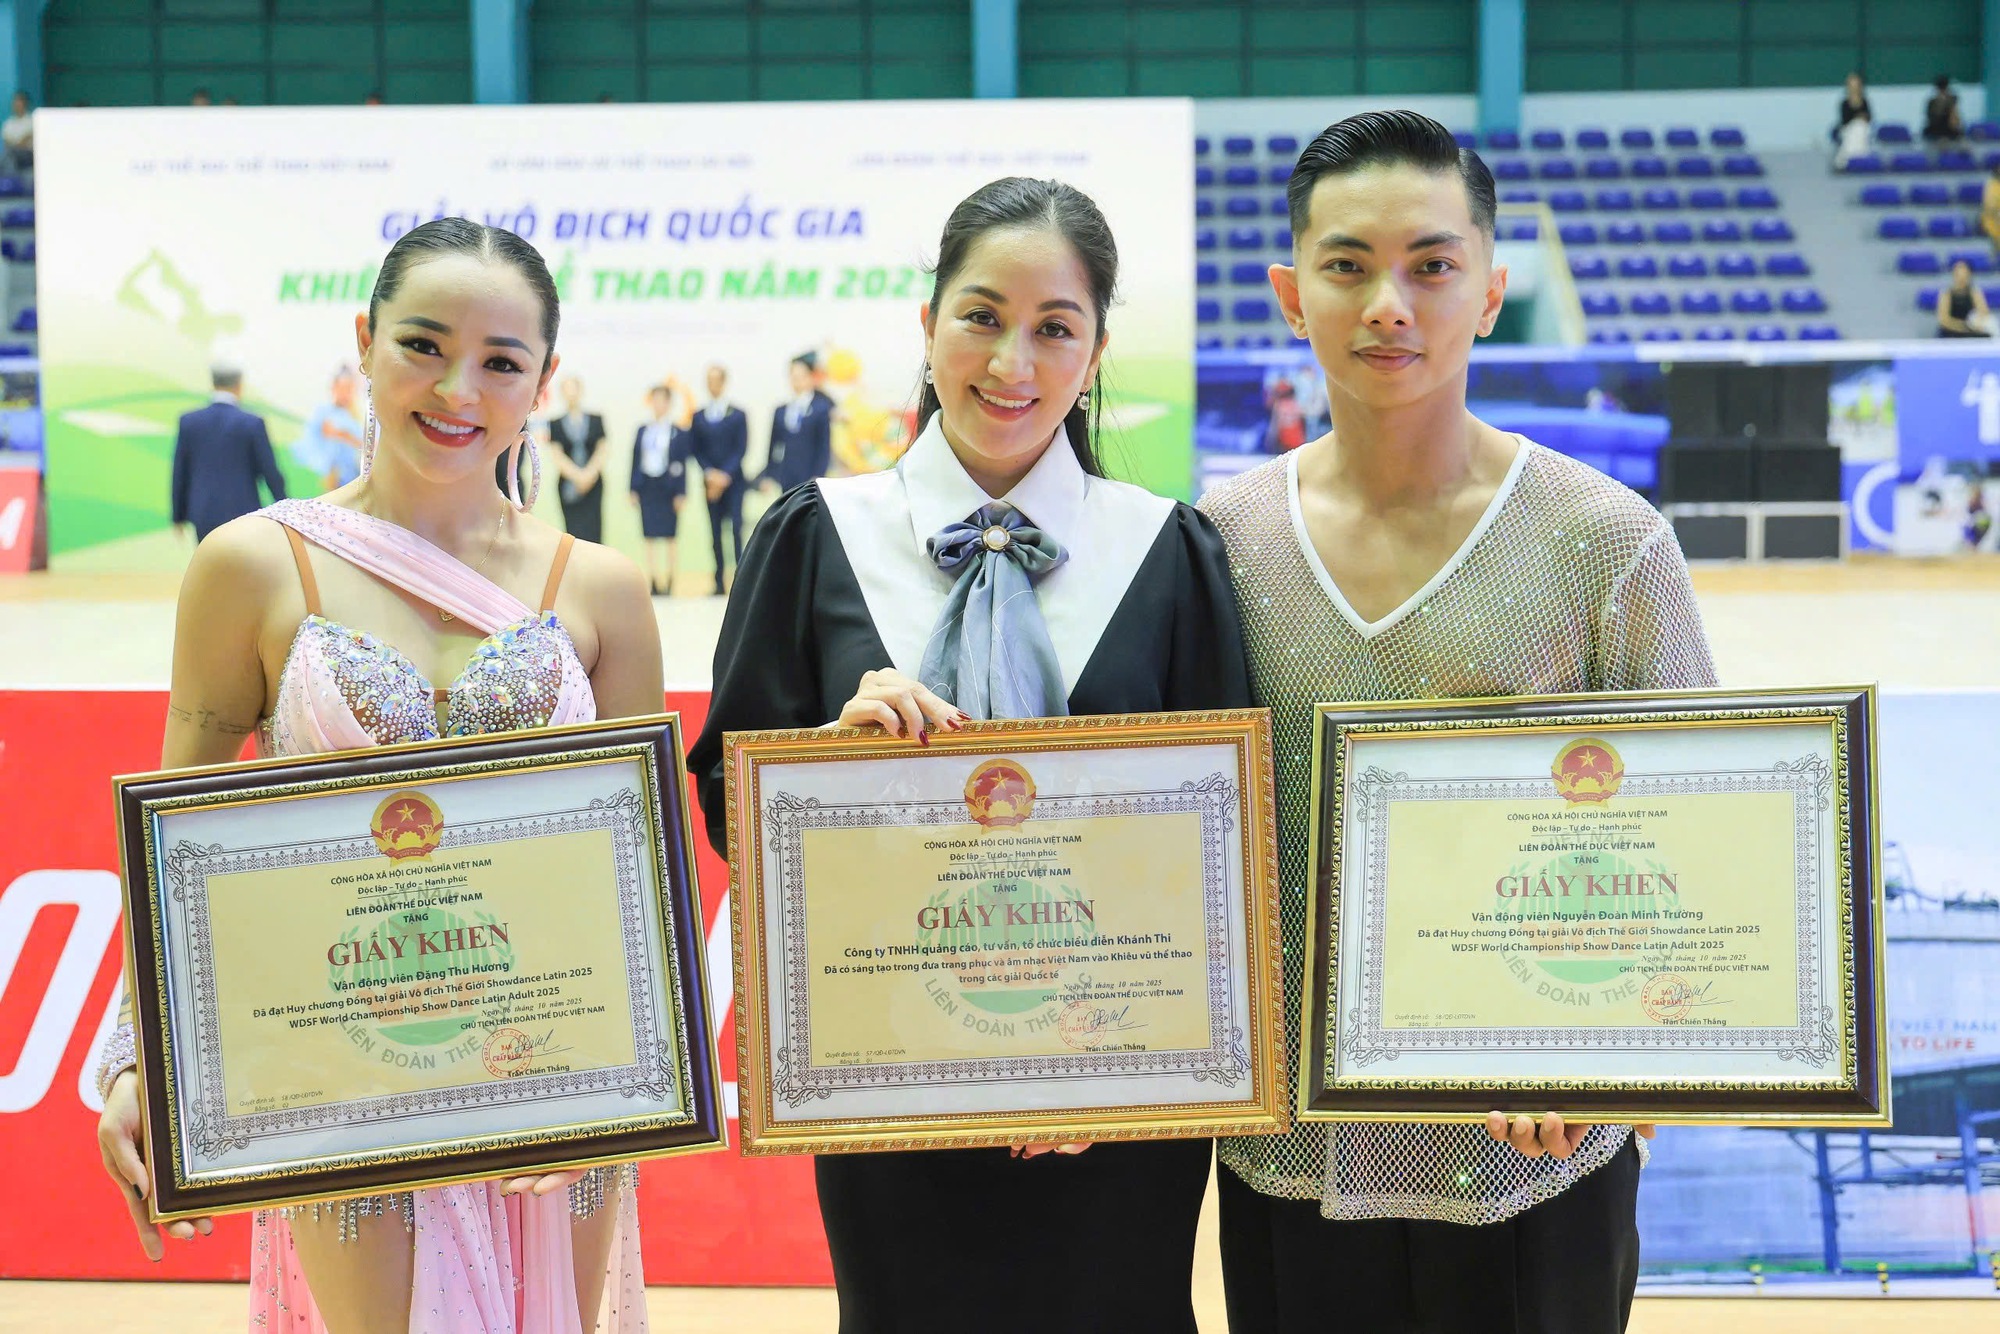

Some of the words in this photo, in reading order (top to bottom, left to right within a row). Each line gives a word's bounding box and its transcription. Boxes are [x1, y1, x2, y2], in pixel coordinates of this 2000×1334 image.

[555, 212, 650, 251] ĐỊCH
[666, 196, 781, 243] QUỐC
[795, 209, 863, 239] GIA
[277, 262, 377, 303] KHIÊ
[592, 268, 704, 301] THAO
[720, 259, 818, 302] NĂM
[330, 875, 354, 885] CỘNG
[355, 872, 374, 882] HÒA
[388, 868, 404, 878] HỘI
[451, 860, 470, 870] VIỆT
[471, 858, 492, 867] NAM
[1573, 855, 1599, 866] TẶNG
[992, 883, 1017, 894] TẶNG
[1495, 868, 1576, 898] GIẤY
[1584, 873, 1678, 896] KHEN
[346, 905, 367, 916] LIÊN
[368, 901, 396, 913] ĐOÀN
[396, 898, 415, 909] THỂ
[416, 895, 437, 908] DỤC
[437, 894, 459, 905] VIỆT
[460, 892, 482, 902] NAM
[917, 898, 996, 930] GIẤY
[1006, 899, 1095, 925] KHEN
[1471, 912, 1492, 924] Vận
[1494, 911, 1523, 923] động
[1526, 911, 1550, 921] viên
[1597, 910, 1628, 920] Đoàn
[1631, 909, 1660, 919] Minh
[1662, 909, 1703, 921] Trường
[402, 912, 428, 924] TẶNG
[327, 931, 408, 966] GIẤY
[416, 922, 509, 955] KHEN
[843, 947, 872, 959] Công
[874, 947, 885, 958] ty
[886, 944, 919, 955] TNHH
[921, 943, 956, 956] quảng
[958, 942, 980, 952] cáo,
[983, 942, 995, 951] tư
[1036, 938, 1061, 948] chức
[1116, 934, 1152, 945] Khánh
[1153, 932, 1171, 943] Thi
[1417, 929, 1430, 937] Đã
[1432, 929, 1448, 939] đạt
[1450, 929, 1469, 939] Huy
[1470, 928, 1506, 938] chương
[1536, 928, 1549, 938] tại
[1551, 927, 1569, 938] giải
[1570, 927, 1583, 936] Vô
[1585, 927, 1606, 938] địch
[1627, 926, 1648, 935] Giới
[1650, 925, 1706, 935] Showdance
[1708, 925, 1733, 933] Latin
[1735, 925, 1760, 933] 2025
[1450, 943, 1479, 951] WDSF
[1480, 942, 1509, 951] World
[1510, 942, 1580, 952] Championship
[1582, 941, 1609, 950] Show
[1610, 941, 1641, 950] Dance
[1643, 941, 1668, 952] Latin
[1669, 940, 1697, 952] Adult
[1699, 940, 1724, 949] 2025
[823, 965, 837, 974] Đã
[838, 964, 850, 973] có
[851, 964, 874, 974] sáng
[875, 964, 892, 973] tạo
[893, 963, 919, 972] trong
[920, 961, 939, 969] đưa
[940, 961, 966, 970] trang
[968, 959, 991, 969] phục
[1006, 957, 1021, 965] âm
[1023, 956, 1045, 966] nhạc
[1047, 955, 1066, 965] Việt
[1067, 954, 1089, 963] Nam
[1091, 953, 1109, 961] vào
[1170, 949, 1192, 958] thao
[333, 980, 355, 993] Vận
[357, 977, 387, 989] động
[389, 973, 413, 984] viên
[415, 970, 446, 982] Đặng
[447, 966, 469, 976] Thu
[471, 962, 509, 973] Hương
[958, 975, 985, 984] trong
[986, 973, 1002, 982] các
[1003, 971, 1021, 983] giải
[1022, 969, 1048, 981] Quốc
[1049, 969, 1059, 979] tế
[252, 1008, 266, 1018] Đã
[267, 1006, 284, 1017] đạt
[286, 1004, 305, 1014] Huy
[307, 1000, 344, 1010] chương
[373, 992, 387, 1003] tại
[388, 990, 407, 1002] giải
[408, 988, 421, 997] Vô
[423, 985, 443, 997] địch
[464, 980, 484, 990] Giới
[486, 975, 541, 988] Showdance
[542, 970, 567, 980] Latin
[568, 966, 592, 977] 2025
[288, 1017, 317, 1028] WDSF
[319, 1012, 348, 1024] World
[349, 1004, 420, 1020] Championship
[421, 1002, 448, 1011] Show
[449, 998, 480, 1008] Dance
[481, 993, 506, 1004] Latin
[507, 989, 534, 1003] Adult
[535, 986, 560, 997] 2025
[1901, 1035, 1926, 1051] TO
[1933, 1037, 1976, 1052] LIFE
